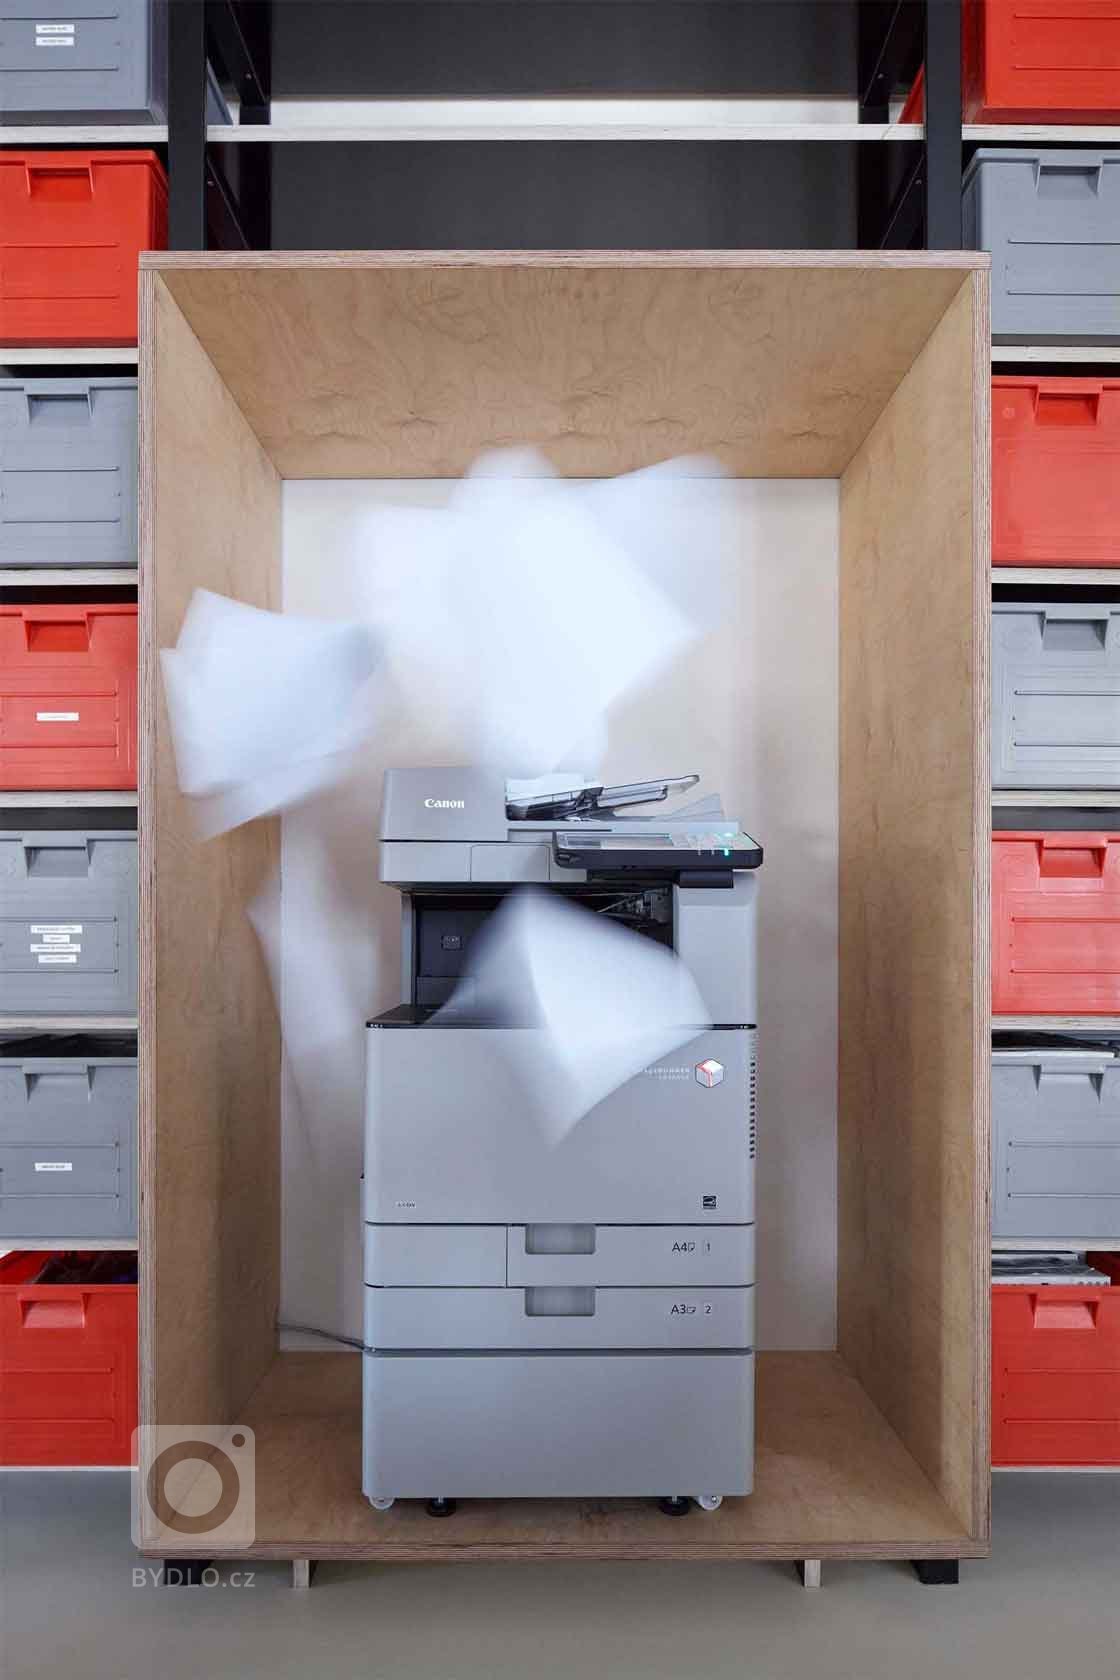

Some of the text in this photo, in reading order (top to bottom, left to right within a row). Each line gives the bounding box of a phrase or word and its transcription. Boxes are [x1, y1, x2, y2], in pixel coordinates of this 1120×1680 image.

[423, 798, 465, 809] Canon
[672, 1242, 687, 1252] A4
[671, 1304, 712, 1314] A3 2
